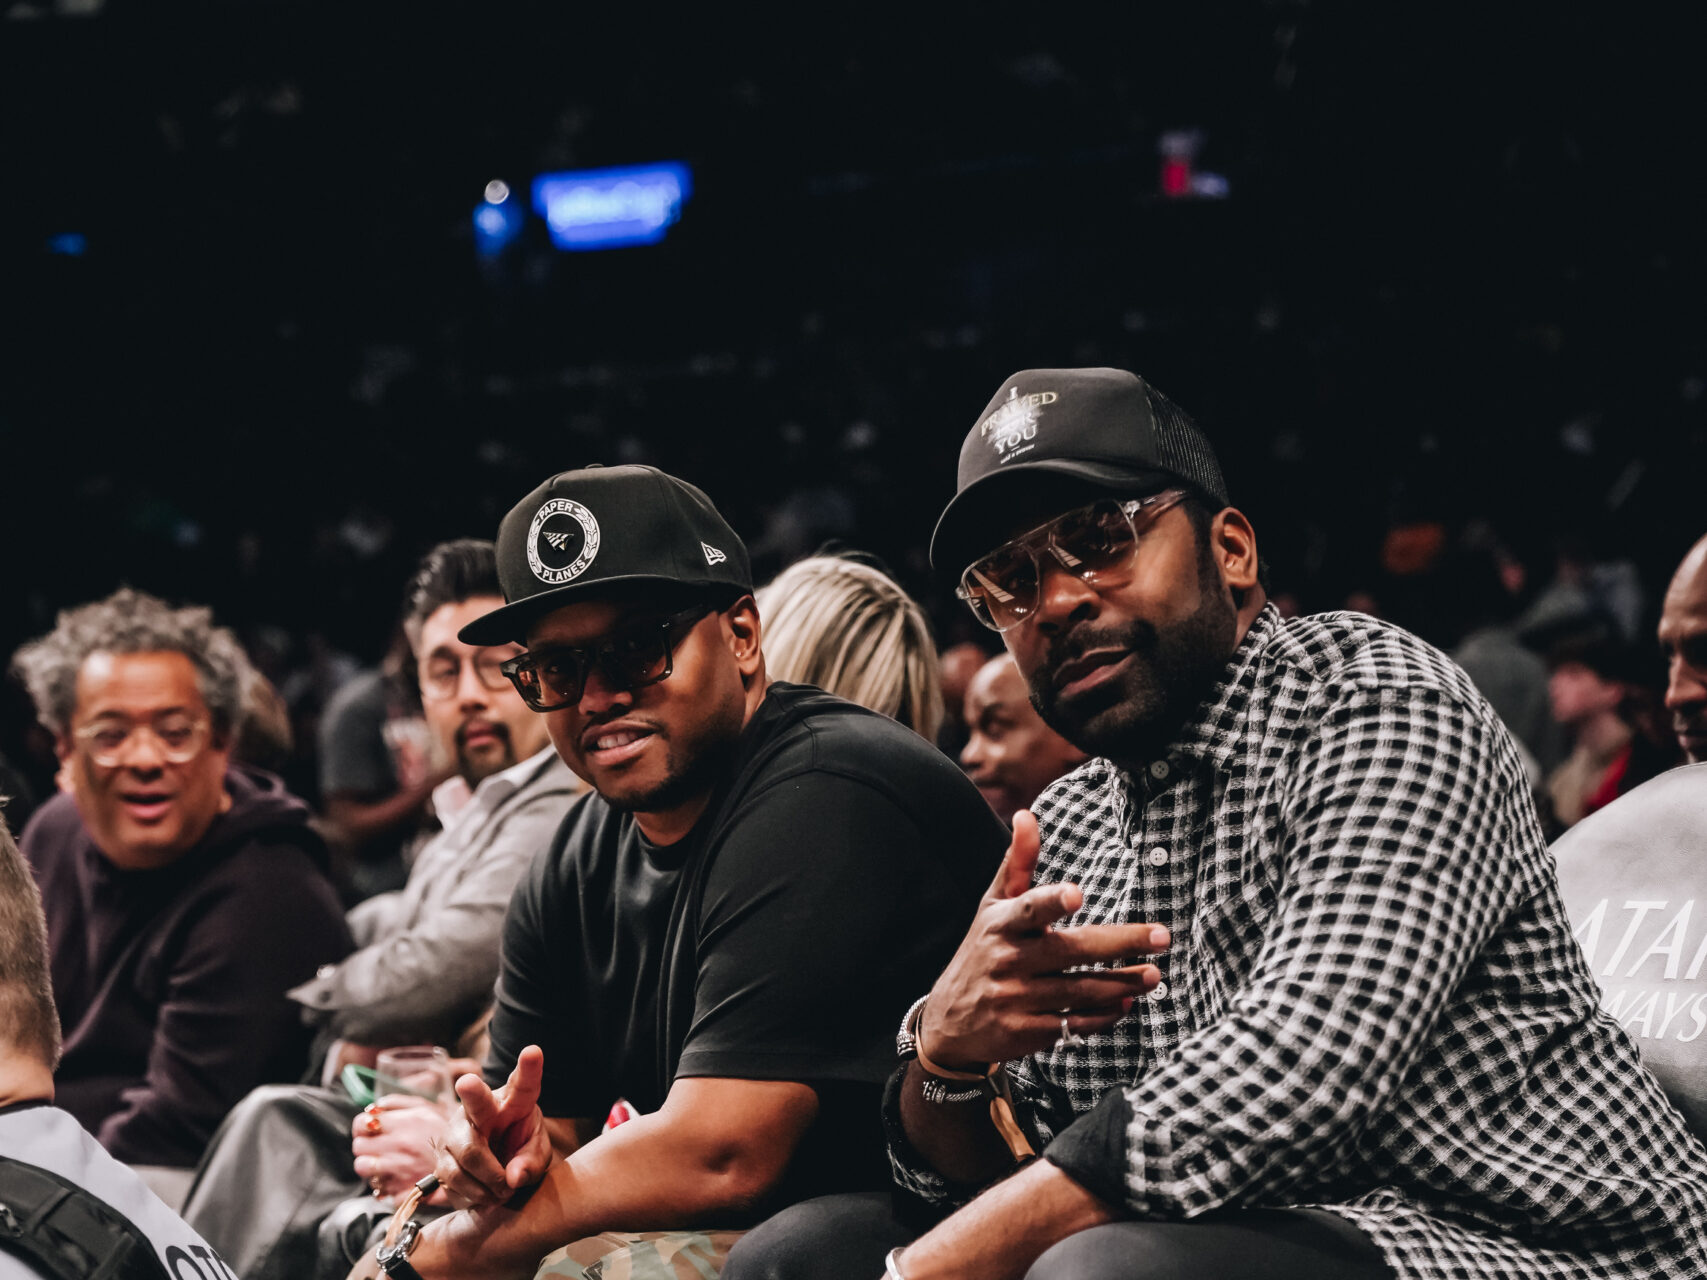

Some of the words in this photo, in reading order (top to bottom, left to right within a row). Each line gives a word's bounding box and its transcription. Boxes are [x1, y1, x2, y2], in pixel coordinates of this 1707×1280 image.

[1009, 386, 1018, 400] I
[994, 424, 1037, 455] YOU
[539, 501, 574, 520] PAPER
[542, 559, 586, 581] PLANES
